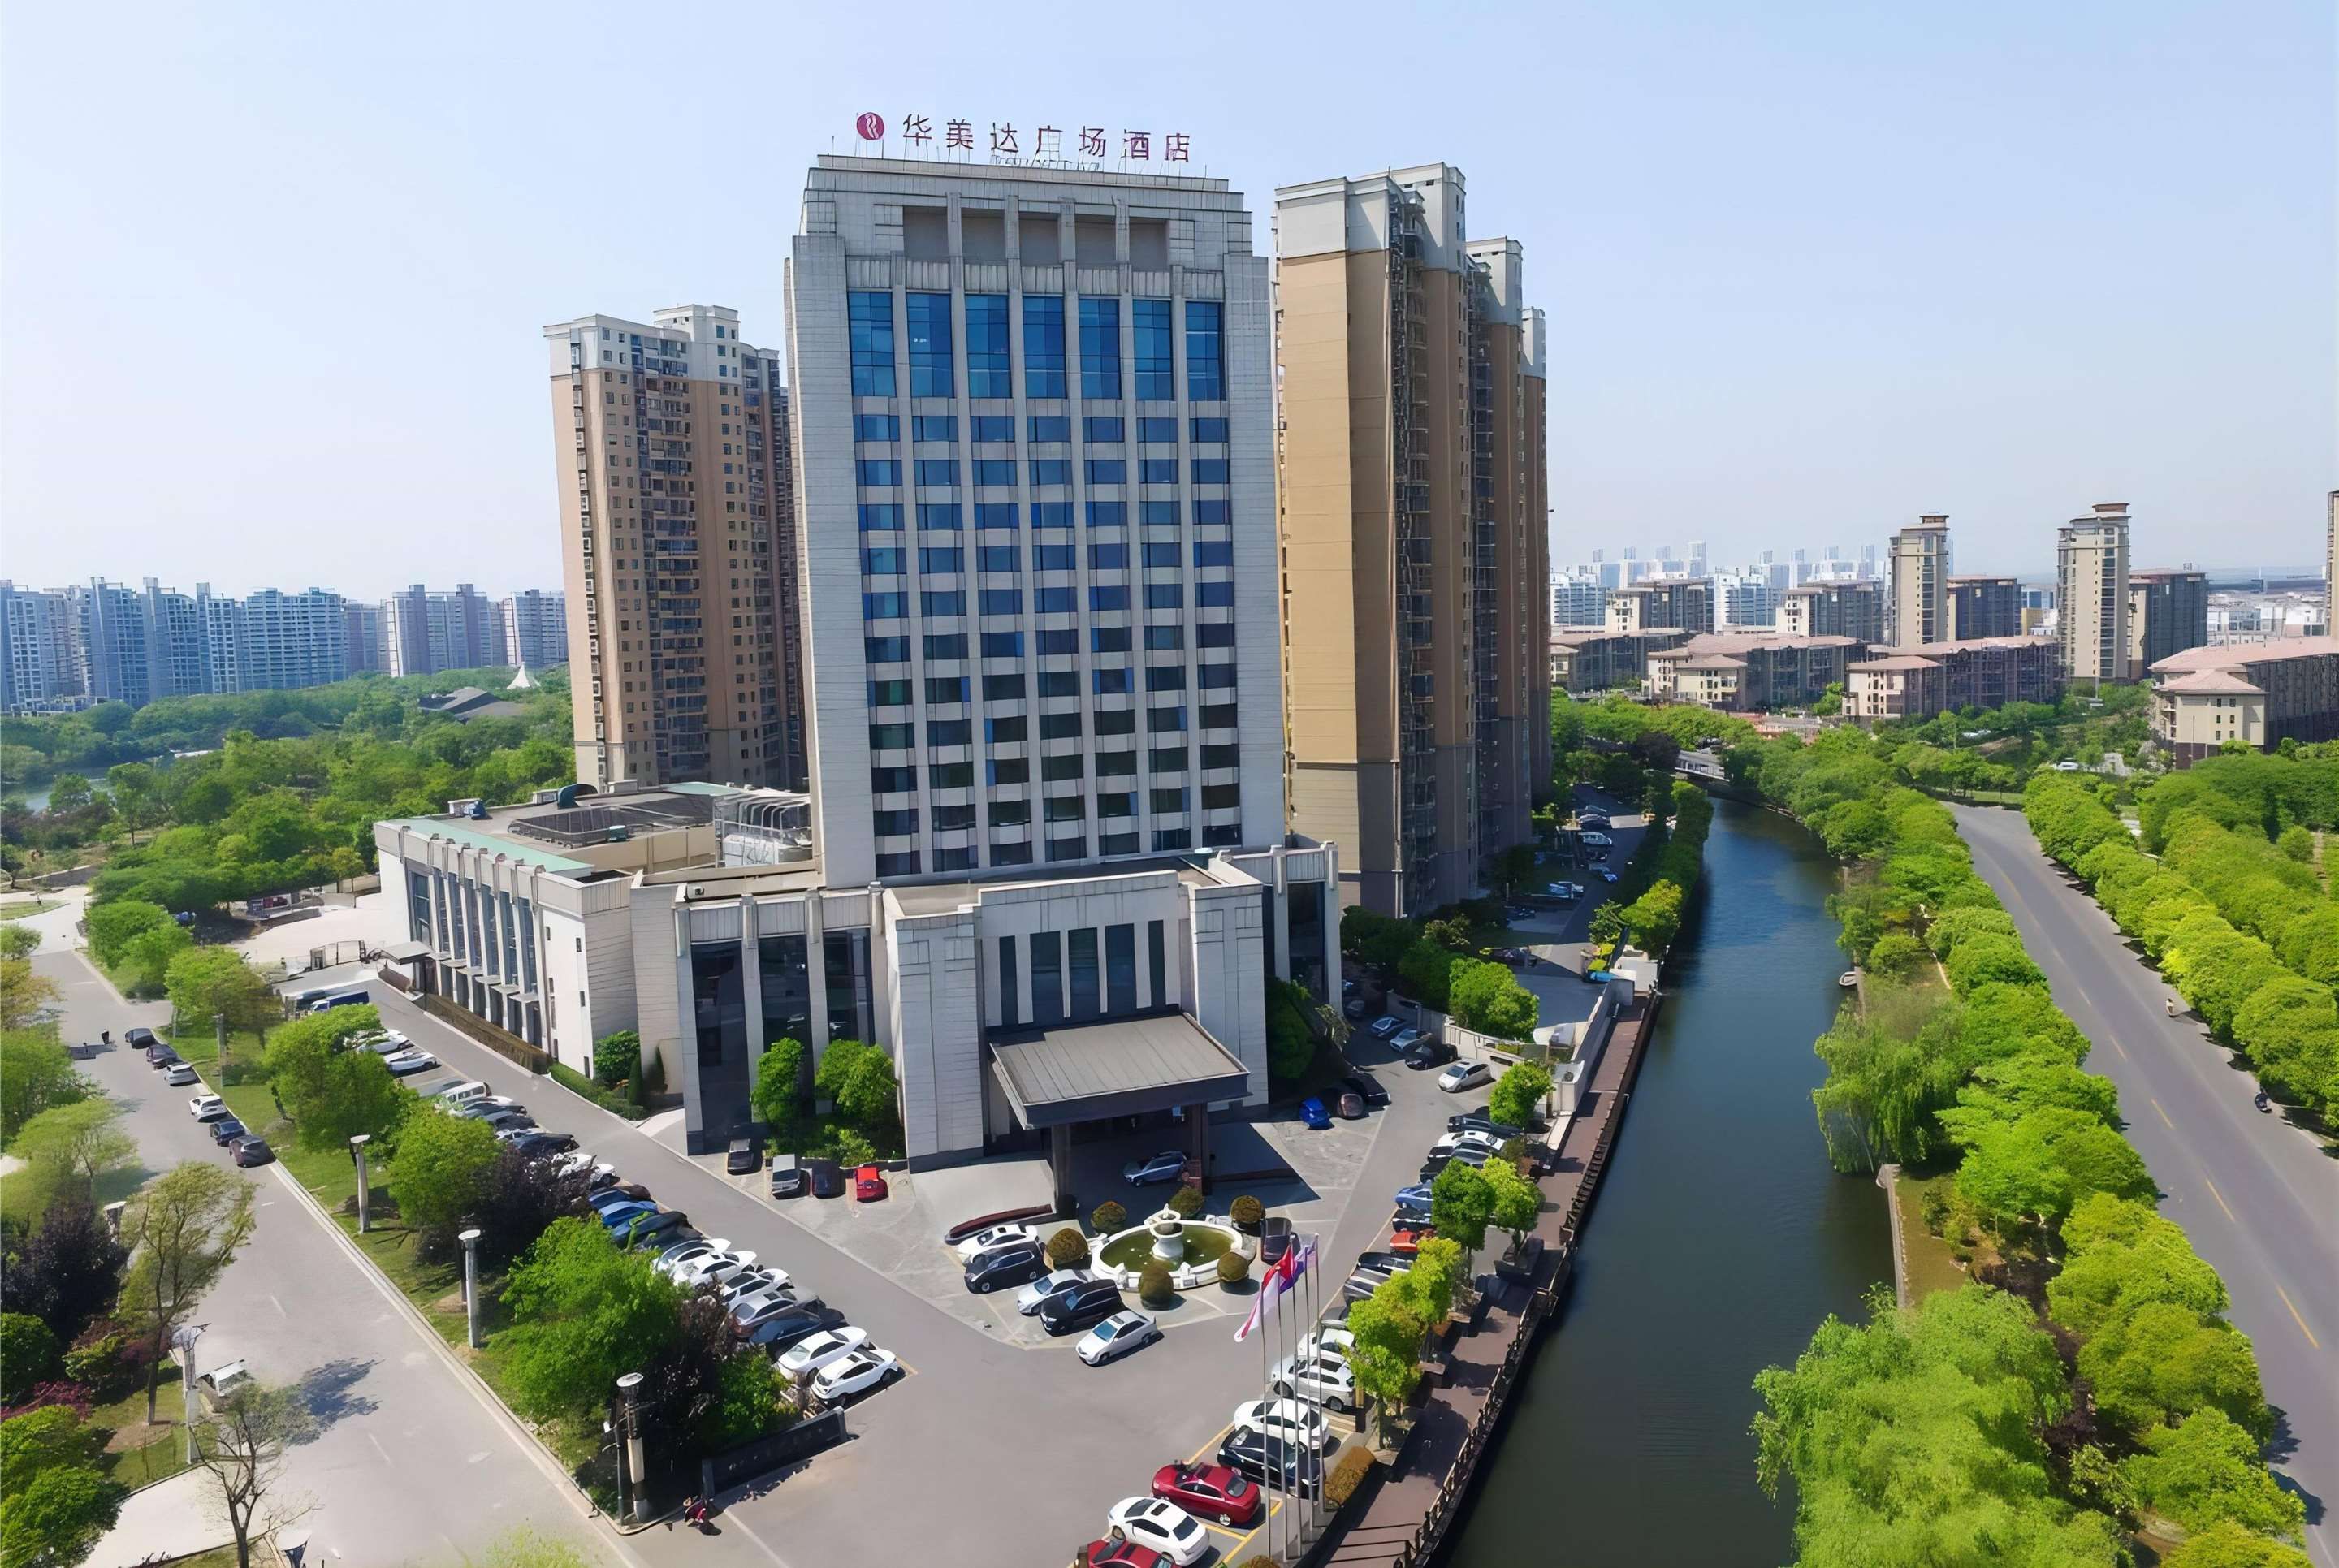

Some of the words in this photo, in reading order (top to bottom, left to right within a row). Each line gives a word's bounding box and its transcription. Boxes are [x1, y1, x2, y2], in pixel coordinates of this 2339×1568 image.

[903, 114, 1190, 162] 华美达广场酒店
